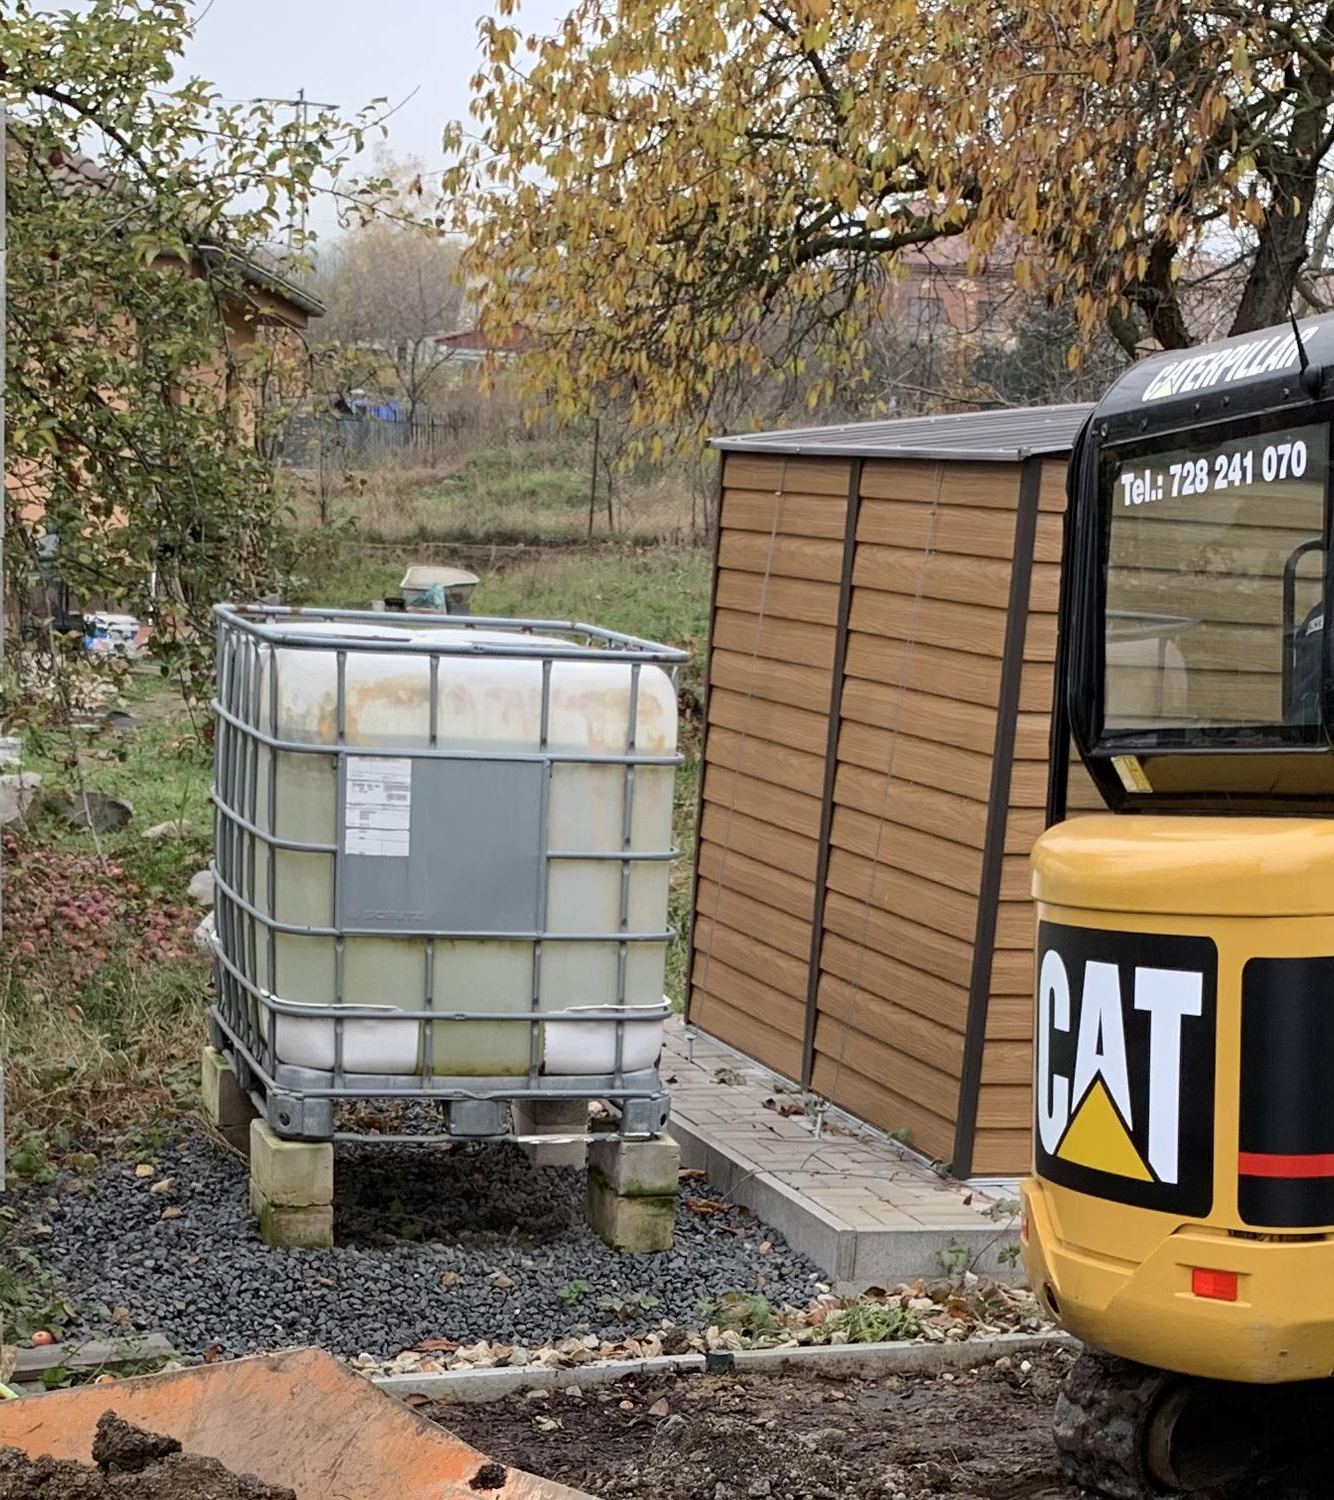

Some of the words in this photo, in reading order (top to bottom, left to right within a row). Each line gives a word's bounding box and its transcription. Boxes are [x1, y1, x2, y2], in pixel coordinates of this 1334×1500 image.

[1121, 469, 1163, 506] Tel.:
[1169, 458, 1209, 498] 728
[1214, 451, 1254, 490] 241
[1262, 441, 1307, 482] 070
[1038, 949, 1204, 1185] CAT
